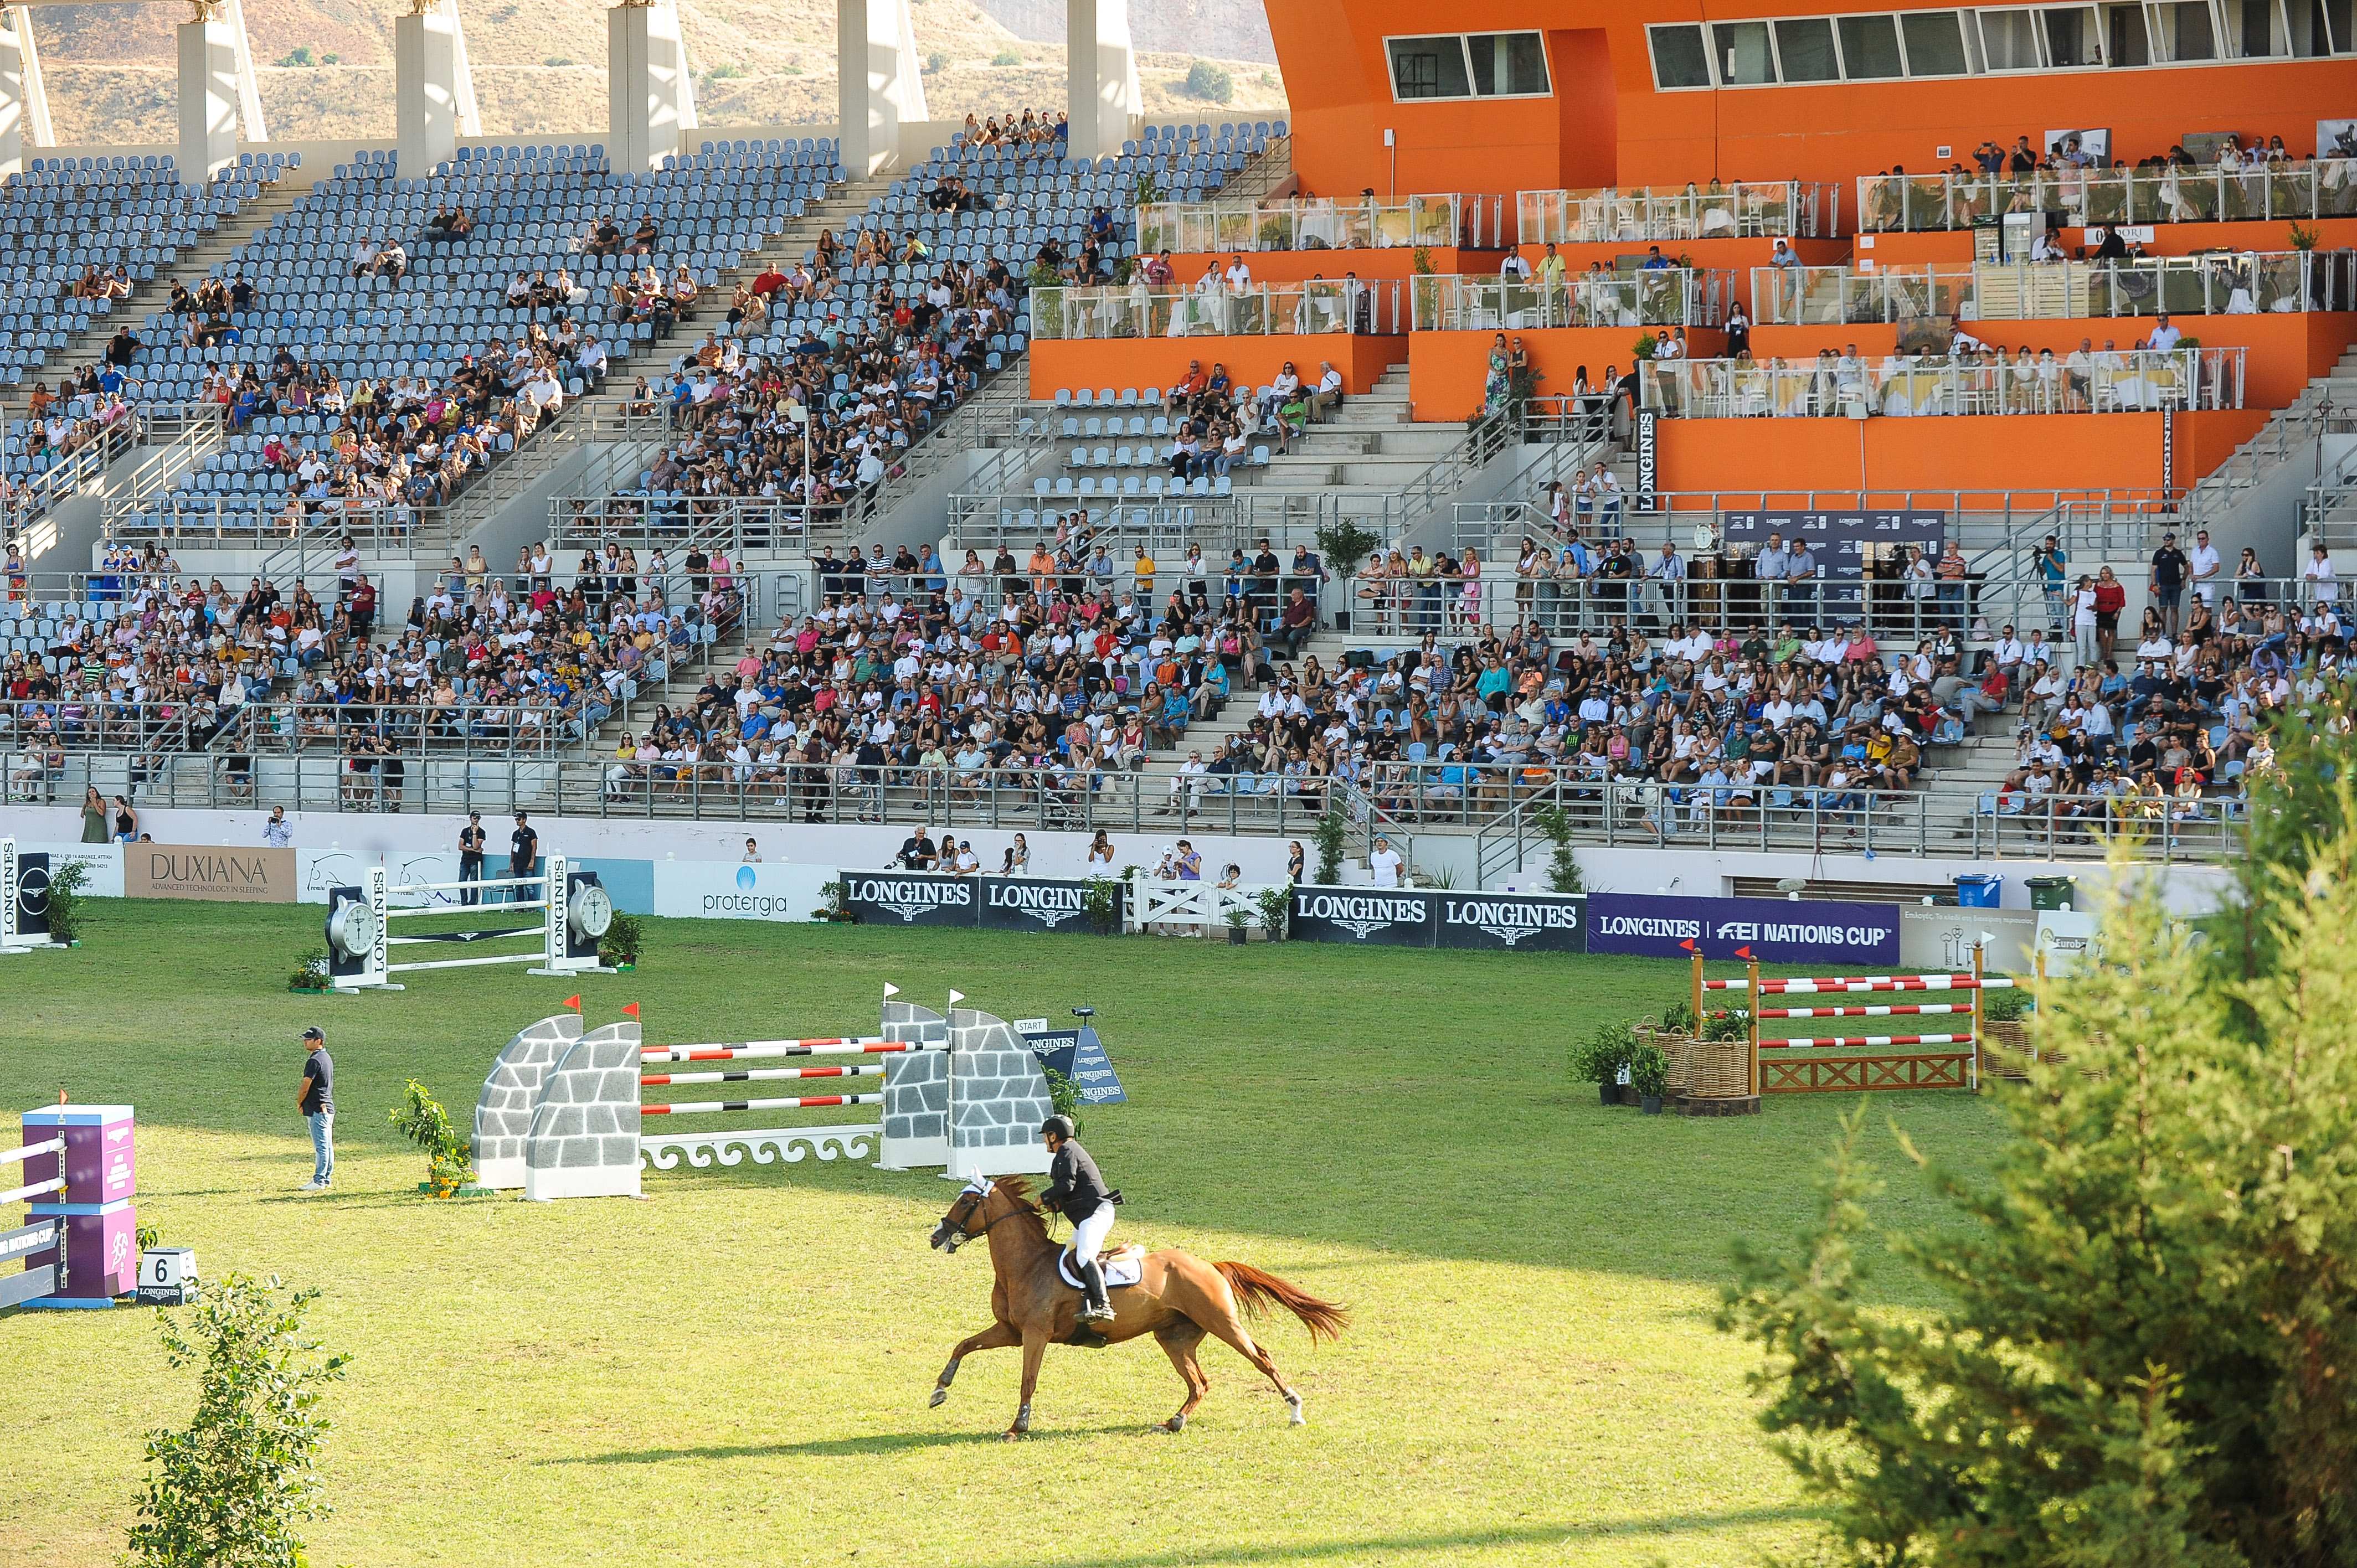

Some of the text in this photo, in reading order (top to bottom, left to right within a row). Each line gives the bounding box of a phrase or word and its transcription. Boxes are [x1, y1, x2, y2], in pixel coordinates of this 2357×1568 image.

[1640, 412, 1654, 510] LONGINES
[4, 842, 14, 936] LONGINES
[187, 884, 230, 893] TECHNOLOGY
[848, 880, 971, 905] LONGINES
[555, 860, 564, 959] LONGINES
[703, 894, 786, 917] protergia
[1298, 895, 1426, 923] LONGINES
[1447, 901, 1577, 929] LONGINES
[374, 871, 384, 974] LONGINES
[1601, 915, 1700, 939] LONGINES
[1717, 921, 1759, 941] FEI
[1764, 923, 1845, 945] NATIONS
[1019, 1022, 1042, 1030] START
[1027, 1037, 1074, 1049] ONGINES
[1074, 1069, 1112, 1080] LONGINES
[155, 1258, 167, 1282] 6
